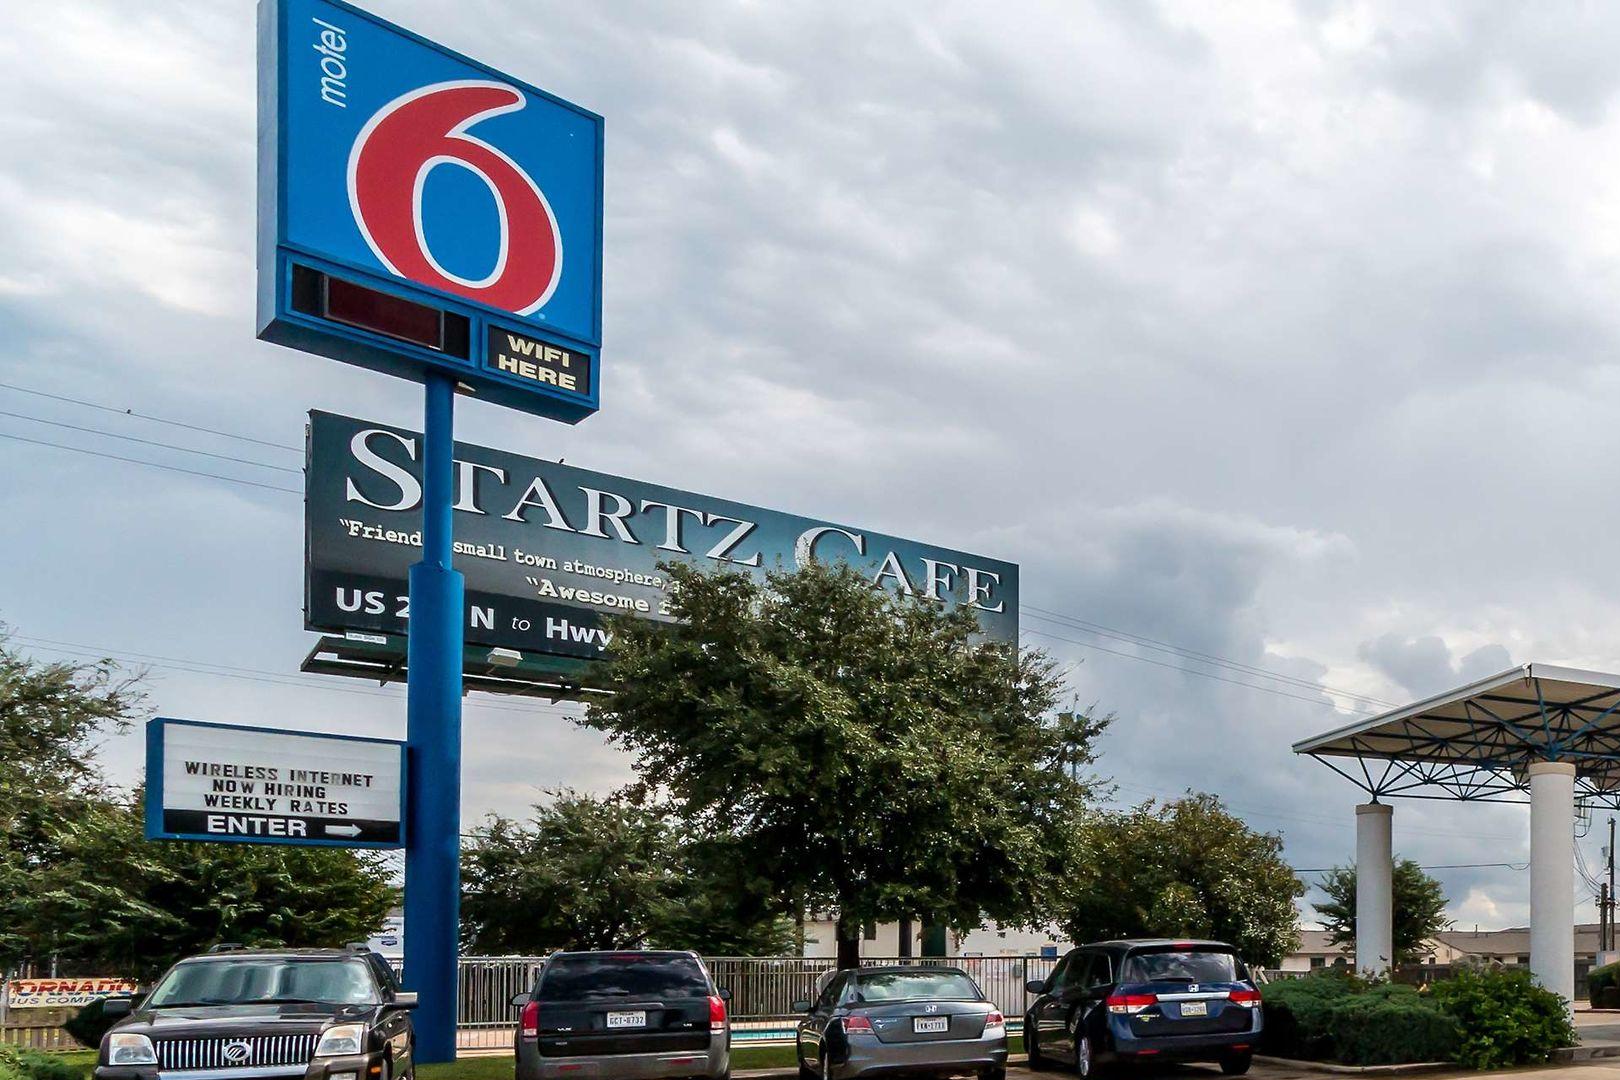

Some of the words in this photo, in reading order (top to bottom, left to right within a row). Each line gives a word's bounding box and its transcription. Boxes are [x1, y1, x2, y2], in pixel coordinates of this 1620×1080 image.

[312, 17, 347, 107] motel
[346, 79, 563, 317] 6
[506, 334, 571, 368] WIFI
[497, 354, 577, 391] HERE
[346, 428, 762, 567] STARTZ
[794, 526, 1004, 613] CAFE
[453, 540, 507, 561] small
[514, 549, 557, 571] town
[563, 558, 667, 591] atmosphere,
[335, 586, 386, 615] US
[470, 605, 495, 631] N
[511, 615, 531, 632] to
[545, 616, 614, 651] Hwy
[185, 760, 278, 781] WIRELESS
[290, 769, 373, 788] INTERNET
[212, 778, 255, 794] NOW
[264, 782, 326, 799] HIRING
[203, 793, 277, 812] WEEKLY
[290, 799, 348, 815] RATES
[206, 814, 306, 837] ENTER
